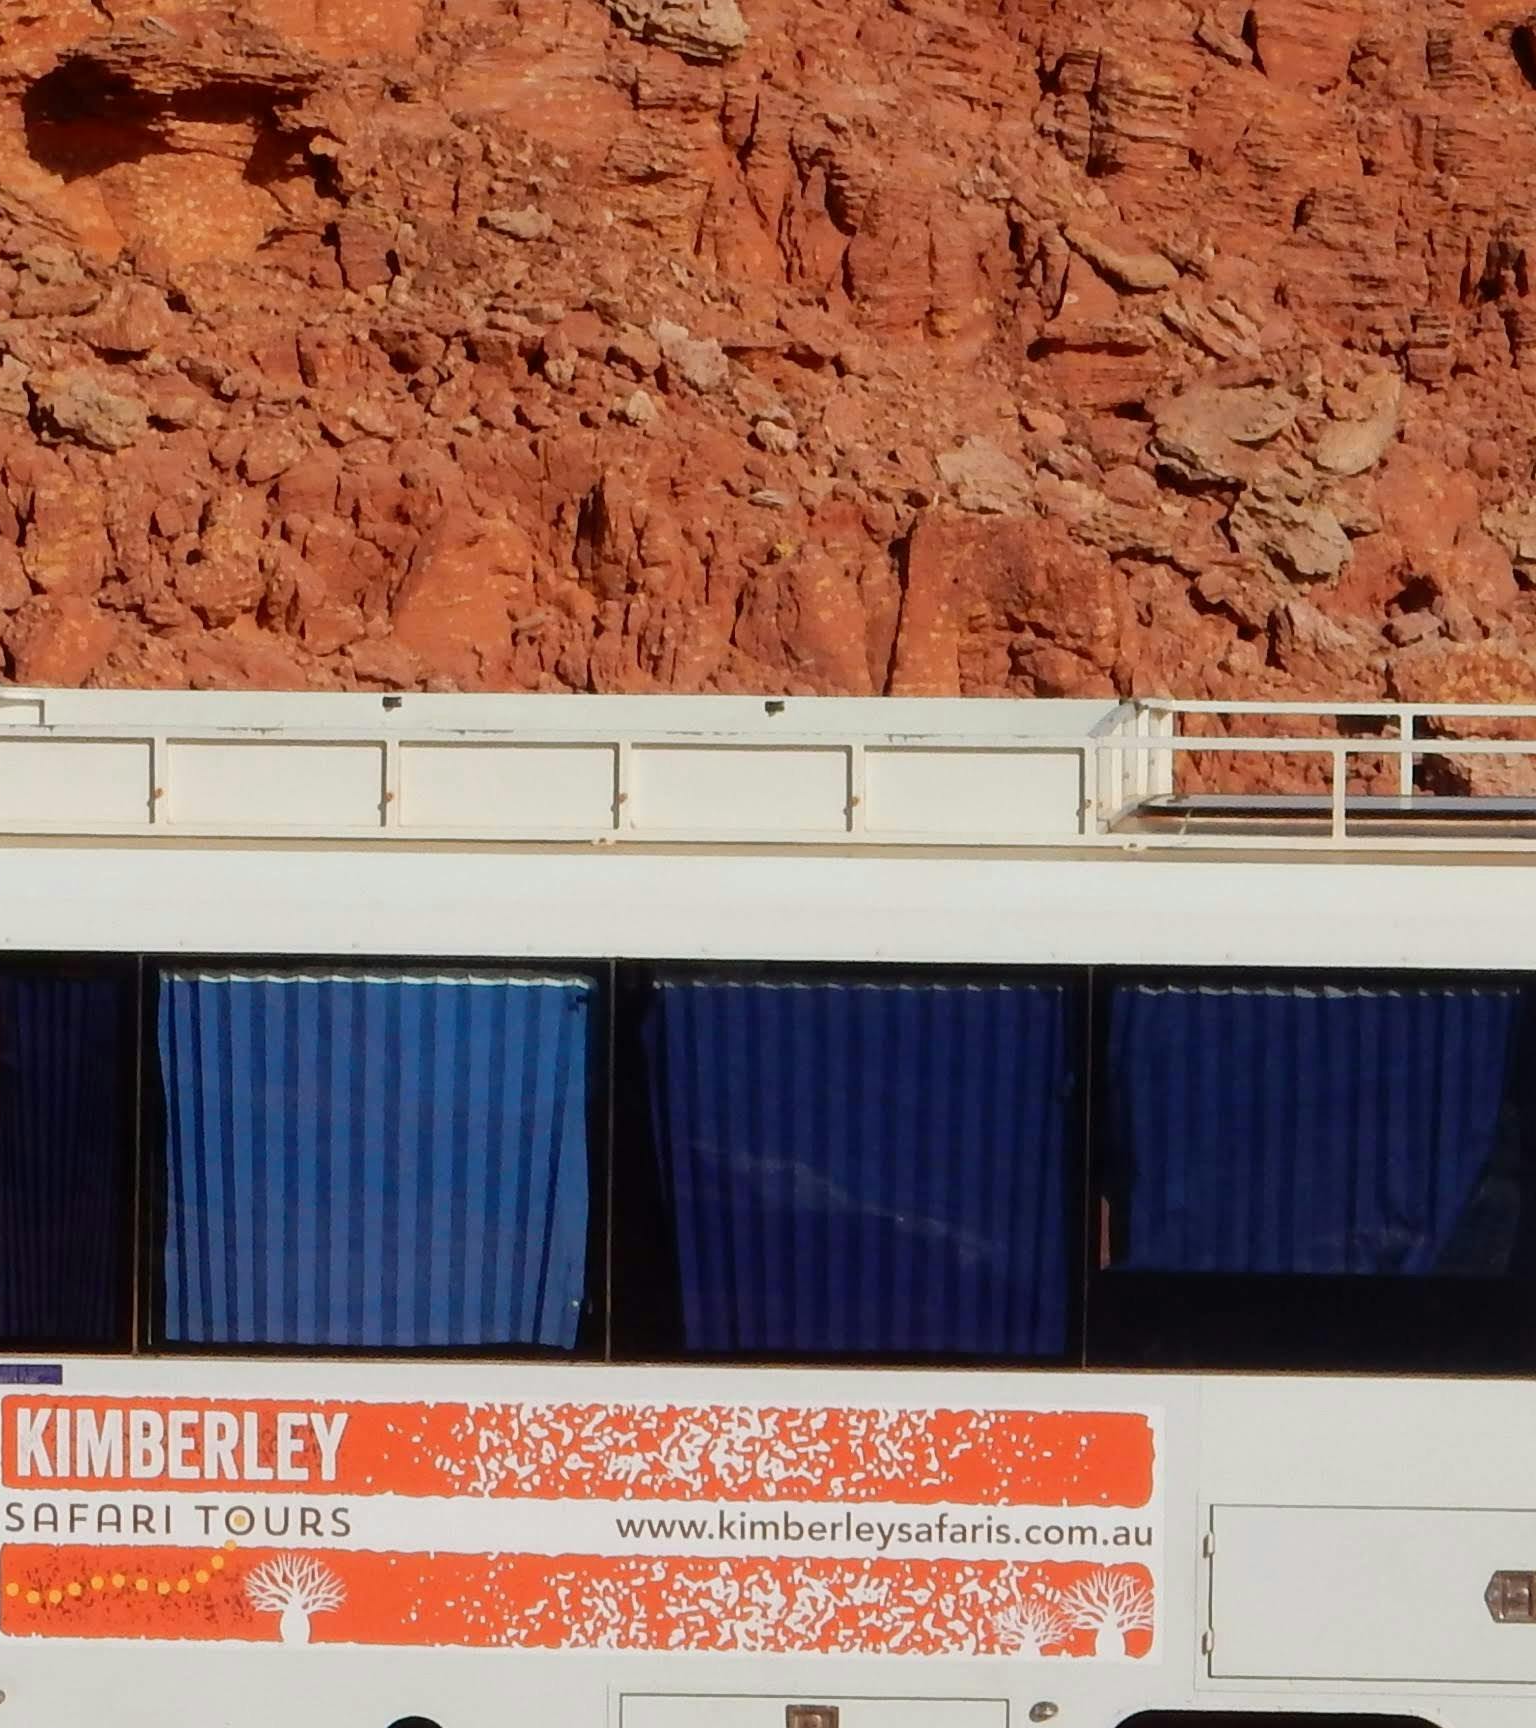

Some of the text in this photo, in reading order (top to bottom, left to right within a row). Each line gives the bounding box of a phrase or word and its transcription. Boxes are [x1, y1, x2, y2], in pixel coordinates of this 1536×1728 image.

[15, 1407, 349, 1482] KIMBERLEY
[4, 1502, 352, 1537] SAFARI TOURS
[615, 1510, 1154, 1551] www.kimberleysafaris.com.au
